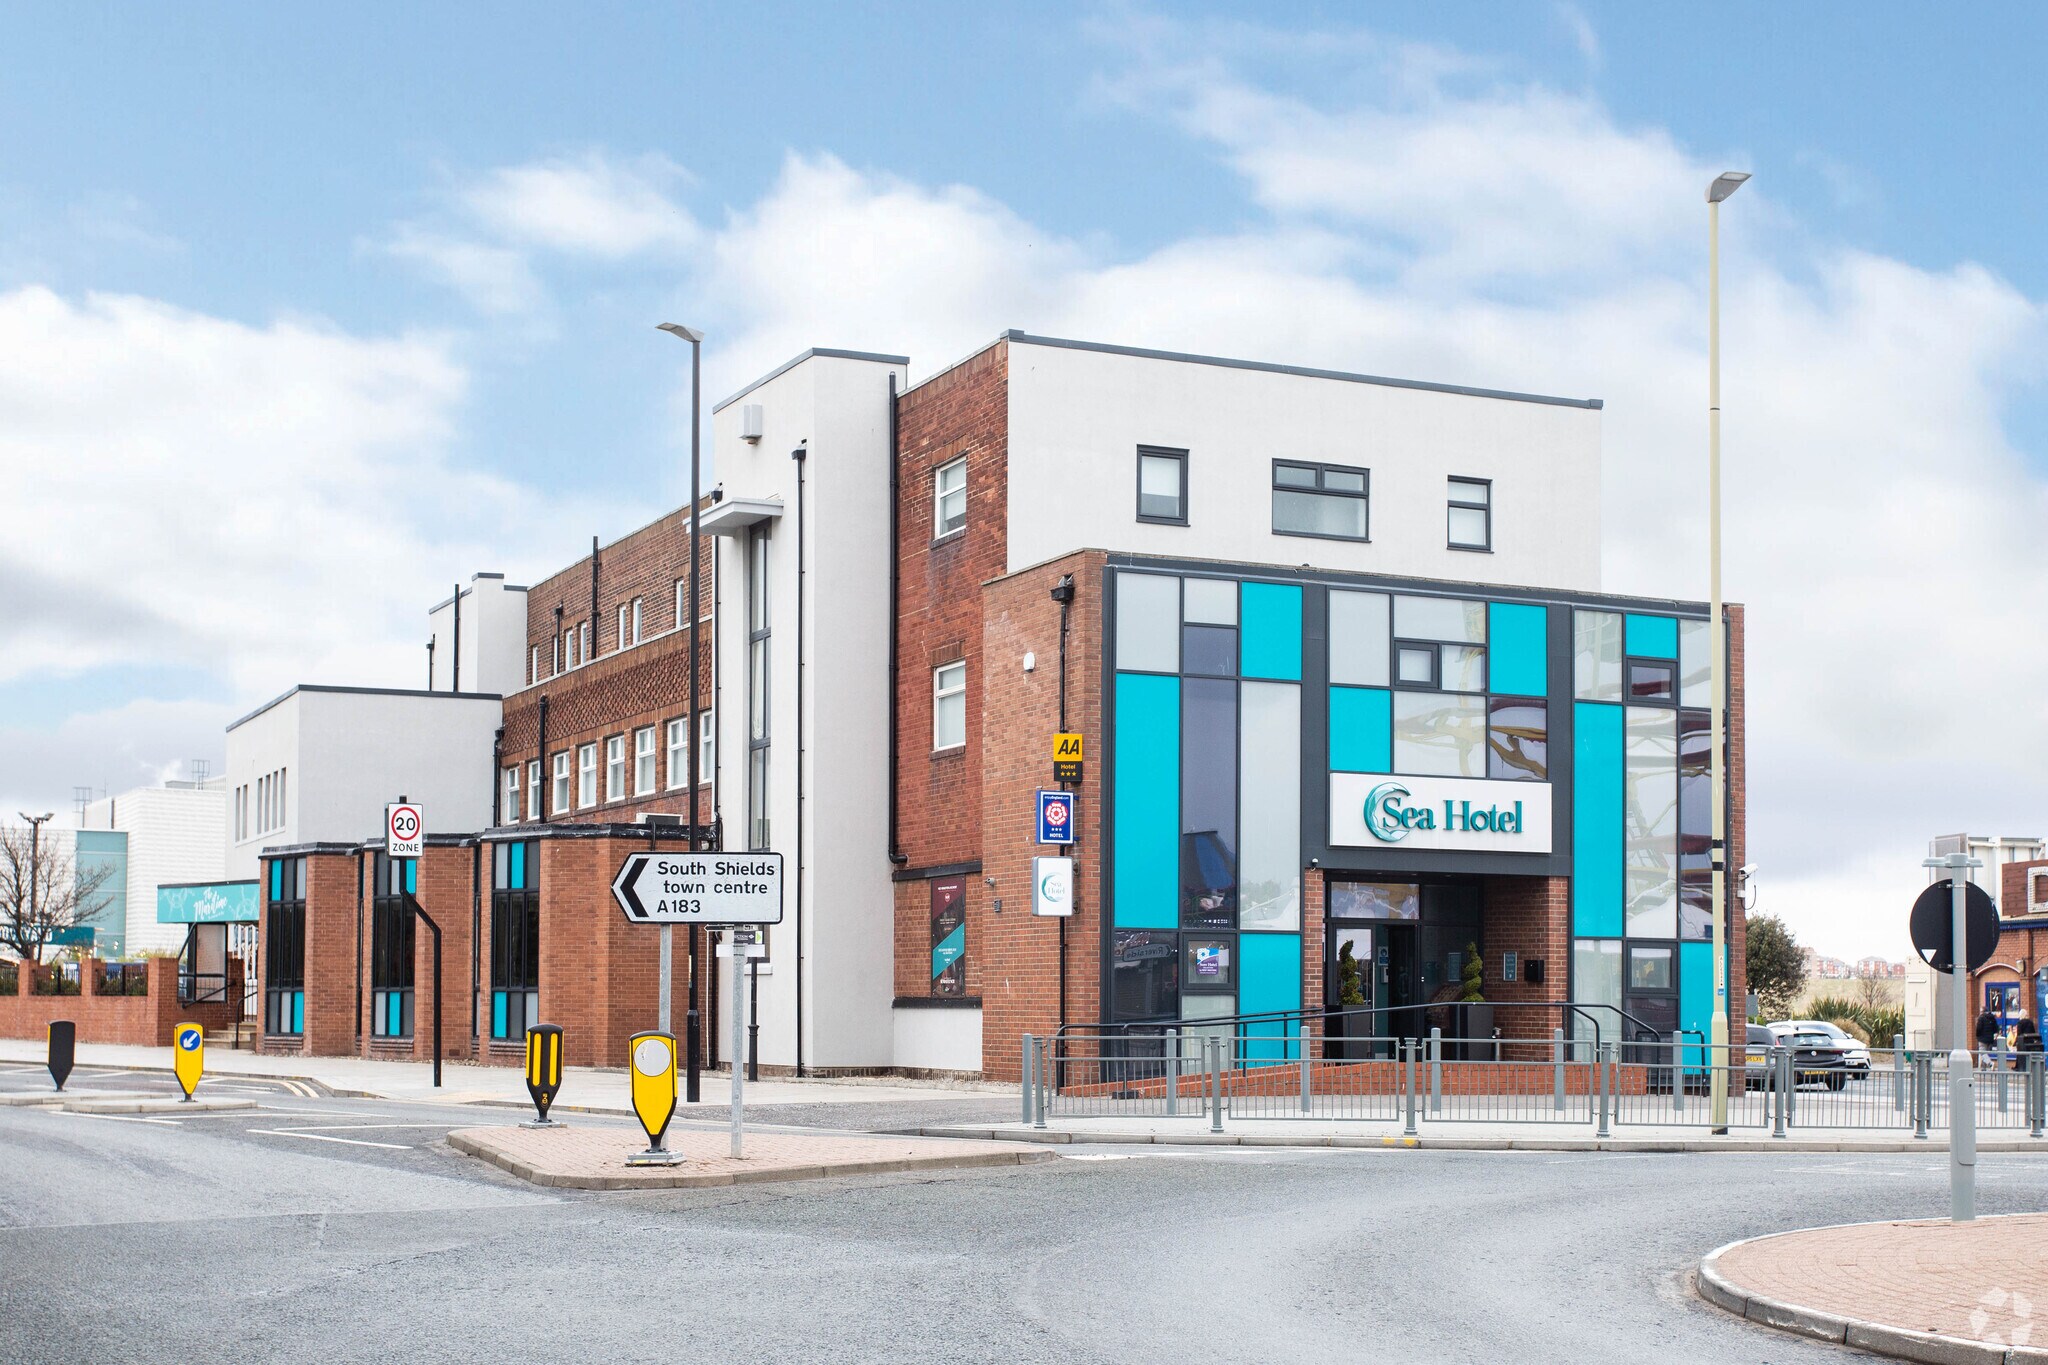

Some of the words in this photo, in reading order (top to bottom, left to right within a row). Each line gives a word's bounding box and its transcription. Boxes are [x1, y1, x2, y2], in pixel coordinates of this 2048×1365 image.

[1057, 739, 1080, 755] AA
[1382, 796, 1437, 830] Sea
[1442, 799, 1524, 834] Hotel
[395, 816, 416, 831] 20
[392, 843, 419, 852] ZONE
[657, 861, 706, 875] South
[714, 861, 775, 875] Shields
[664, 880, 705, 894] town
[713, 880, 768, 894] centre
[657, 899, 701, 914] A183
